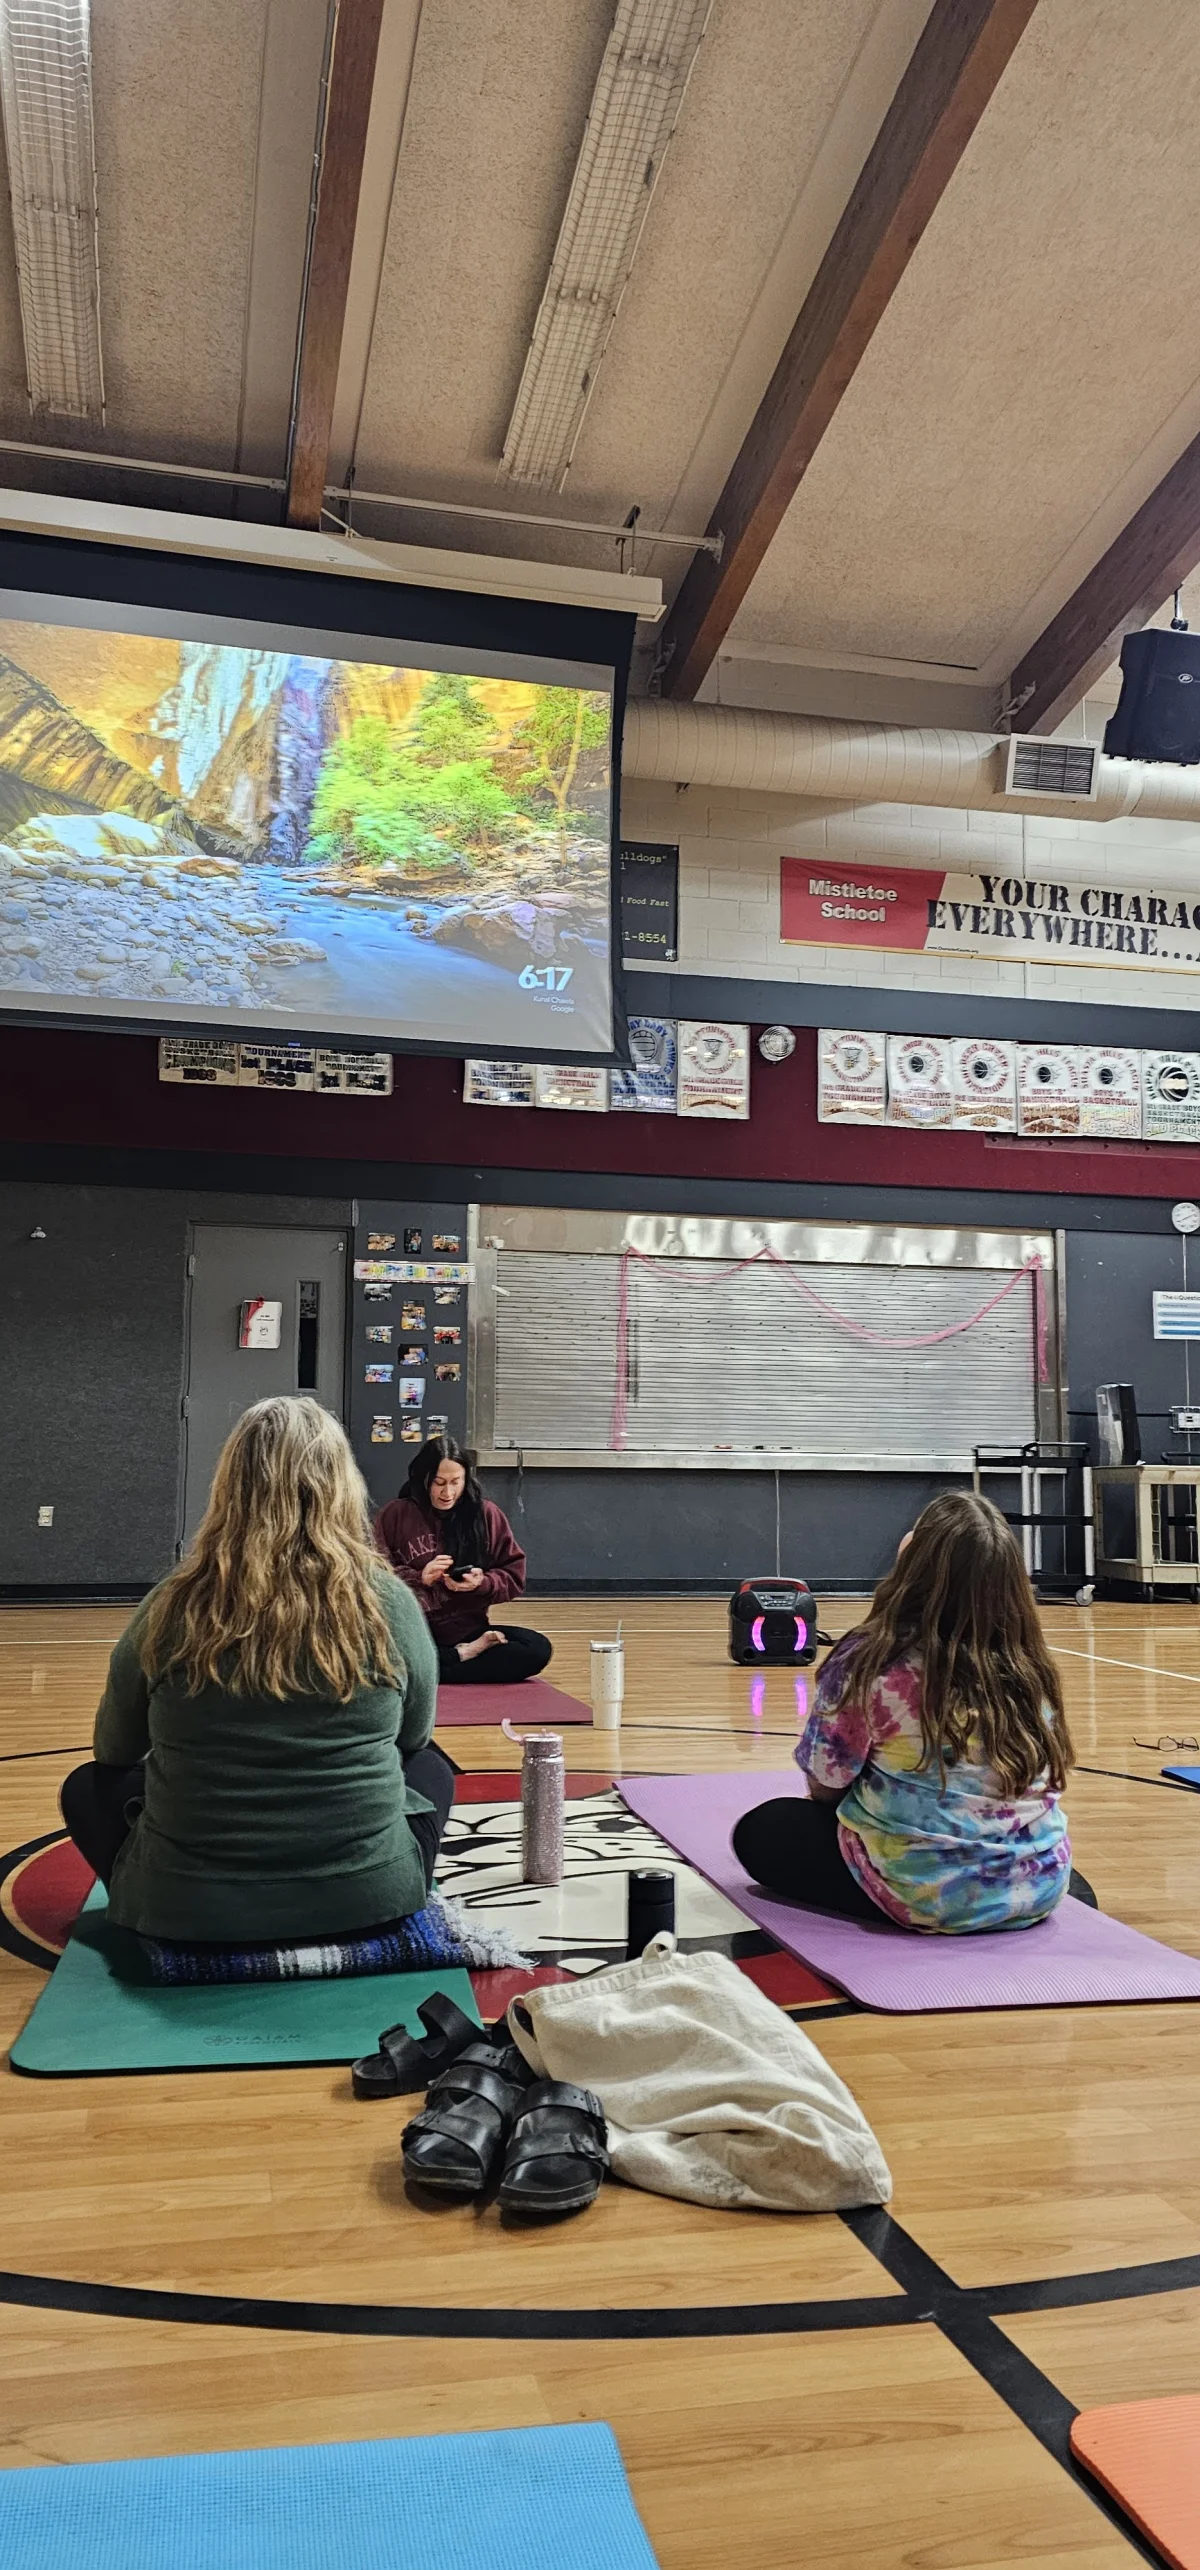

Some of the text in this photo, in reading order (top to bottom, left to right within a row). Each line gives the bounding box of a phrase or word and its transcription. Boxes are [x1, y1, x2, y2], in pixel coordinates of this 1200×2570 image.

[808, 878, 898, 902] Mistletoe
[978, 875, 1072, 914] YOUR
[820, 901, 886, 922] School
[518, 964, 574, 991] 6:17
[550, 1004, 574, 1014] Google
[245, 1047, 311, 1059] TOURNAMENT
[1083, 1096, 1138, 1106] BASKETBALL
[393, 1533, 438, 1565] LAKE
